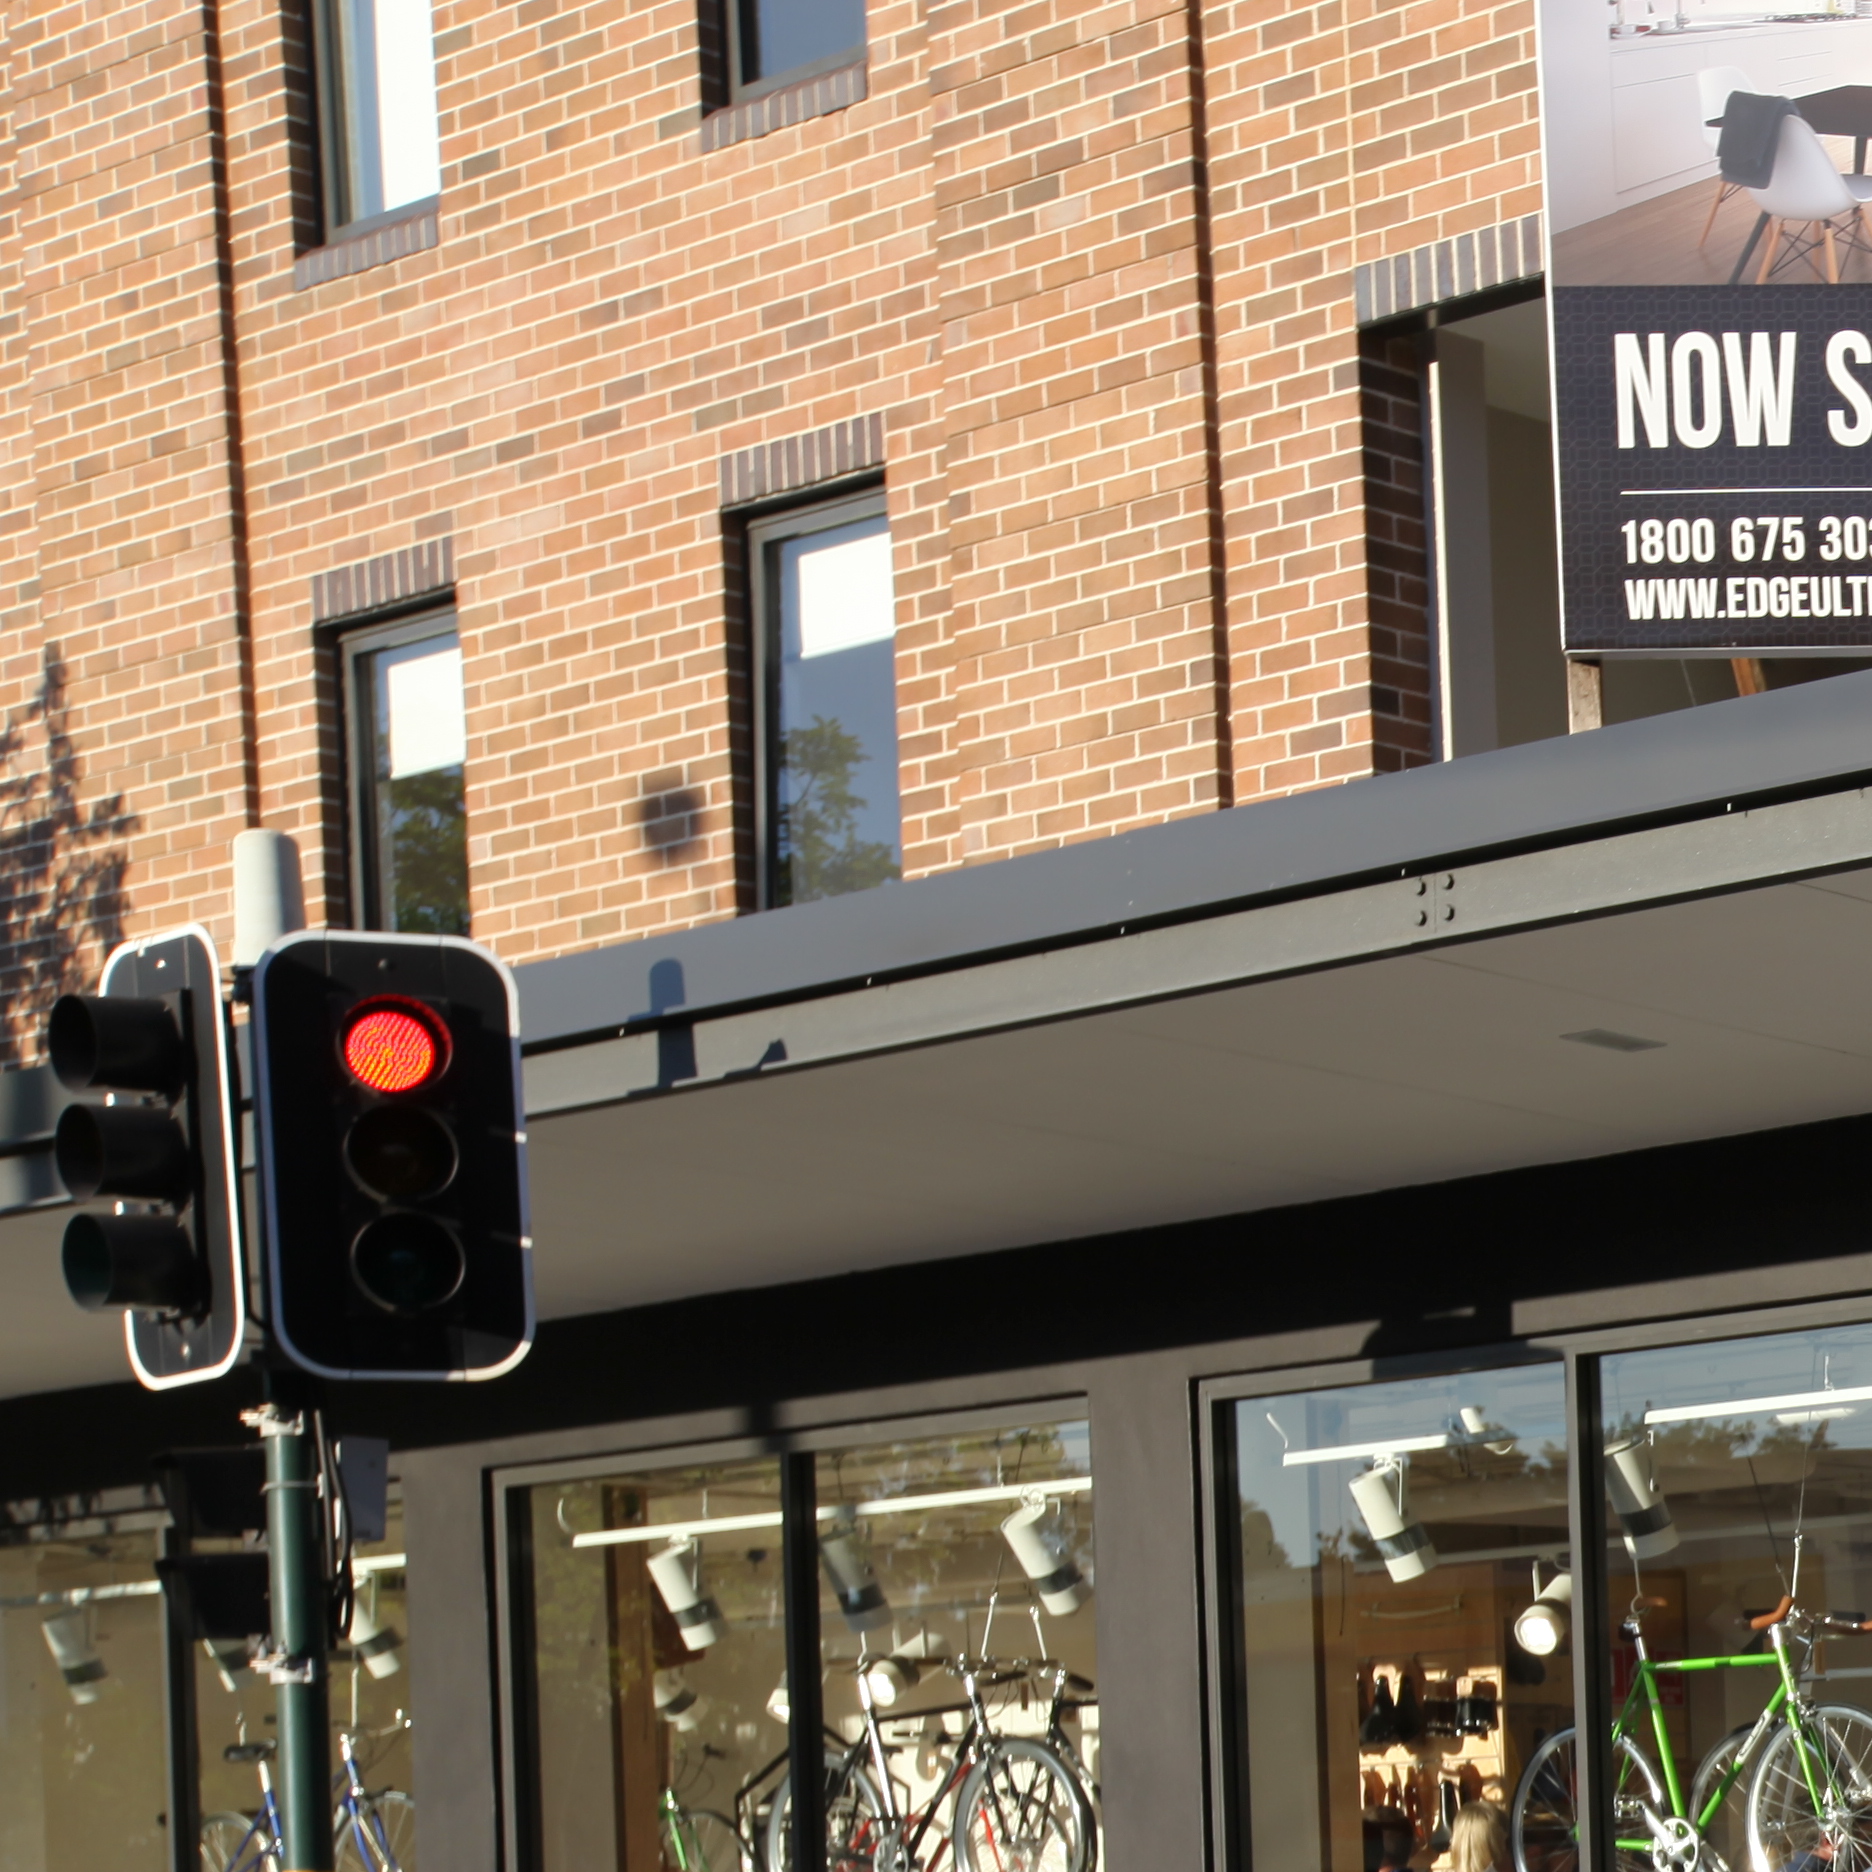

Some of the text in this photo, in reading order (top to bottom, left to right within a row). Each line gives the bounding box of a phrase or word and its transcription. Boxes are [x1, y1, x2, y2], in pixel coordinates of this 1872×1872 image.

[1613, 331, 1797, 449] NOW
[1621, 517, 1715, 564] 1800
[1730, 516, 1806, 562] 675
